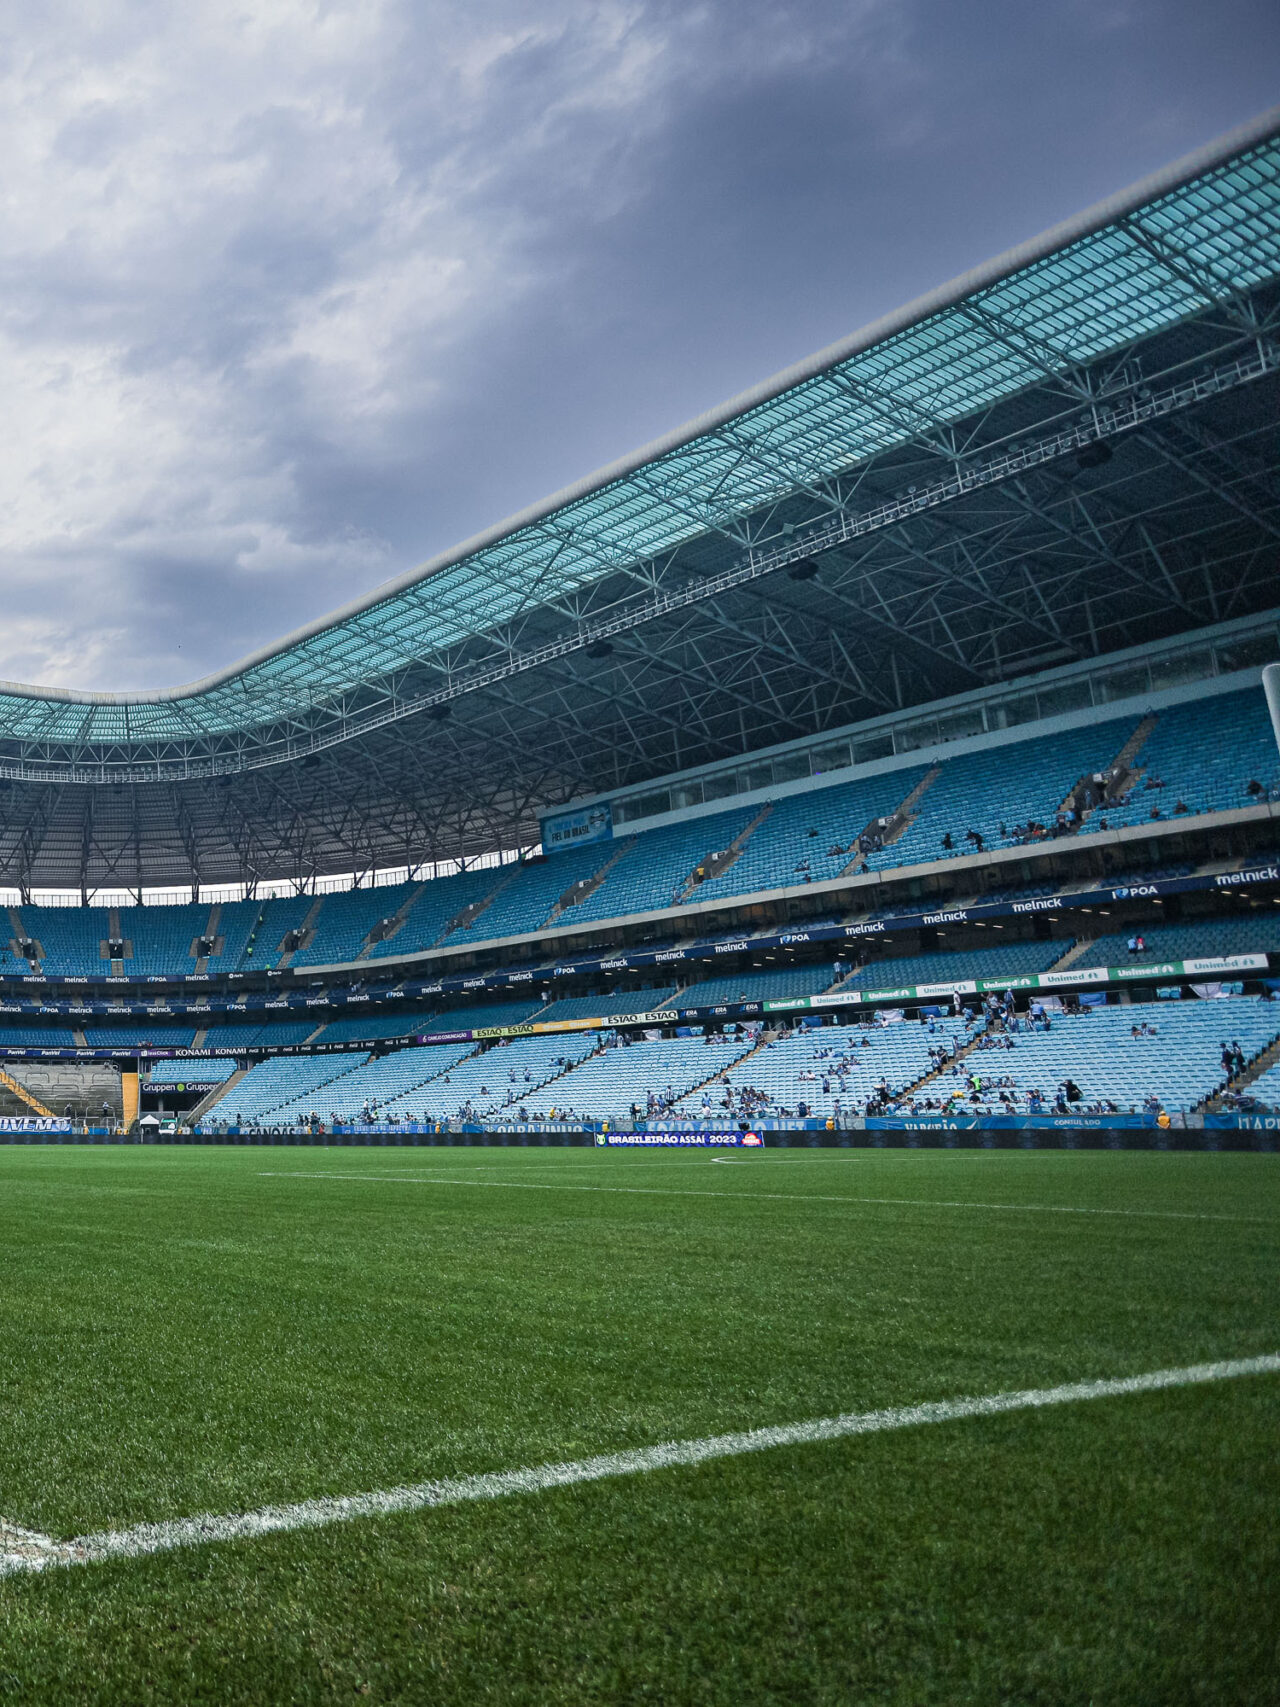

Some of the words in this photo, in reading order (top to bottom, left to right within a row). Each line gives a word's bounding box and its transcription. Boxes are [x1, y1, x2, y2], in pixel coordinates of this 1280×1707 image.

[1216, 867, 1278, 885] melnick
[1130, 885, 1158, 896] POA
[1013, 898, 1062, 912] melnick
[923, 911, 966, 925] melnick
[846, 922, 885, 935] melnick
[792, 934, 809, 942] POA
[715, 942, 748, 953] melnick
[656, 951, 685, 961] melnick
[601, 959, 628, 969] melnick
[1194, 958, 1238, 970] Unimed
[1118, 965, 1159, 977] Unimed
[509, 972, 533, 981] melnick
[1047, 972, 1085, 982] Unimed
[464, 979, 485, 988] melnick
[983, 978, 1018, 990] Unimed
[422, 985, 441, 994] melnick
[923, 984, 953, 994] Unimed
[347, 994, 369, 1002] melnick
[869, 990, 899, 999] Unimed
[770, 999, 795, 1008] Unimed
[817, 996, 844, 1004] Unimed
[143, 1084, 175, 1092] Gruppen
[608, 1134, 678, 1144] BRASILEIRÃO
[679, 1134, 705, 1144] ASSAÍ
